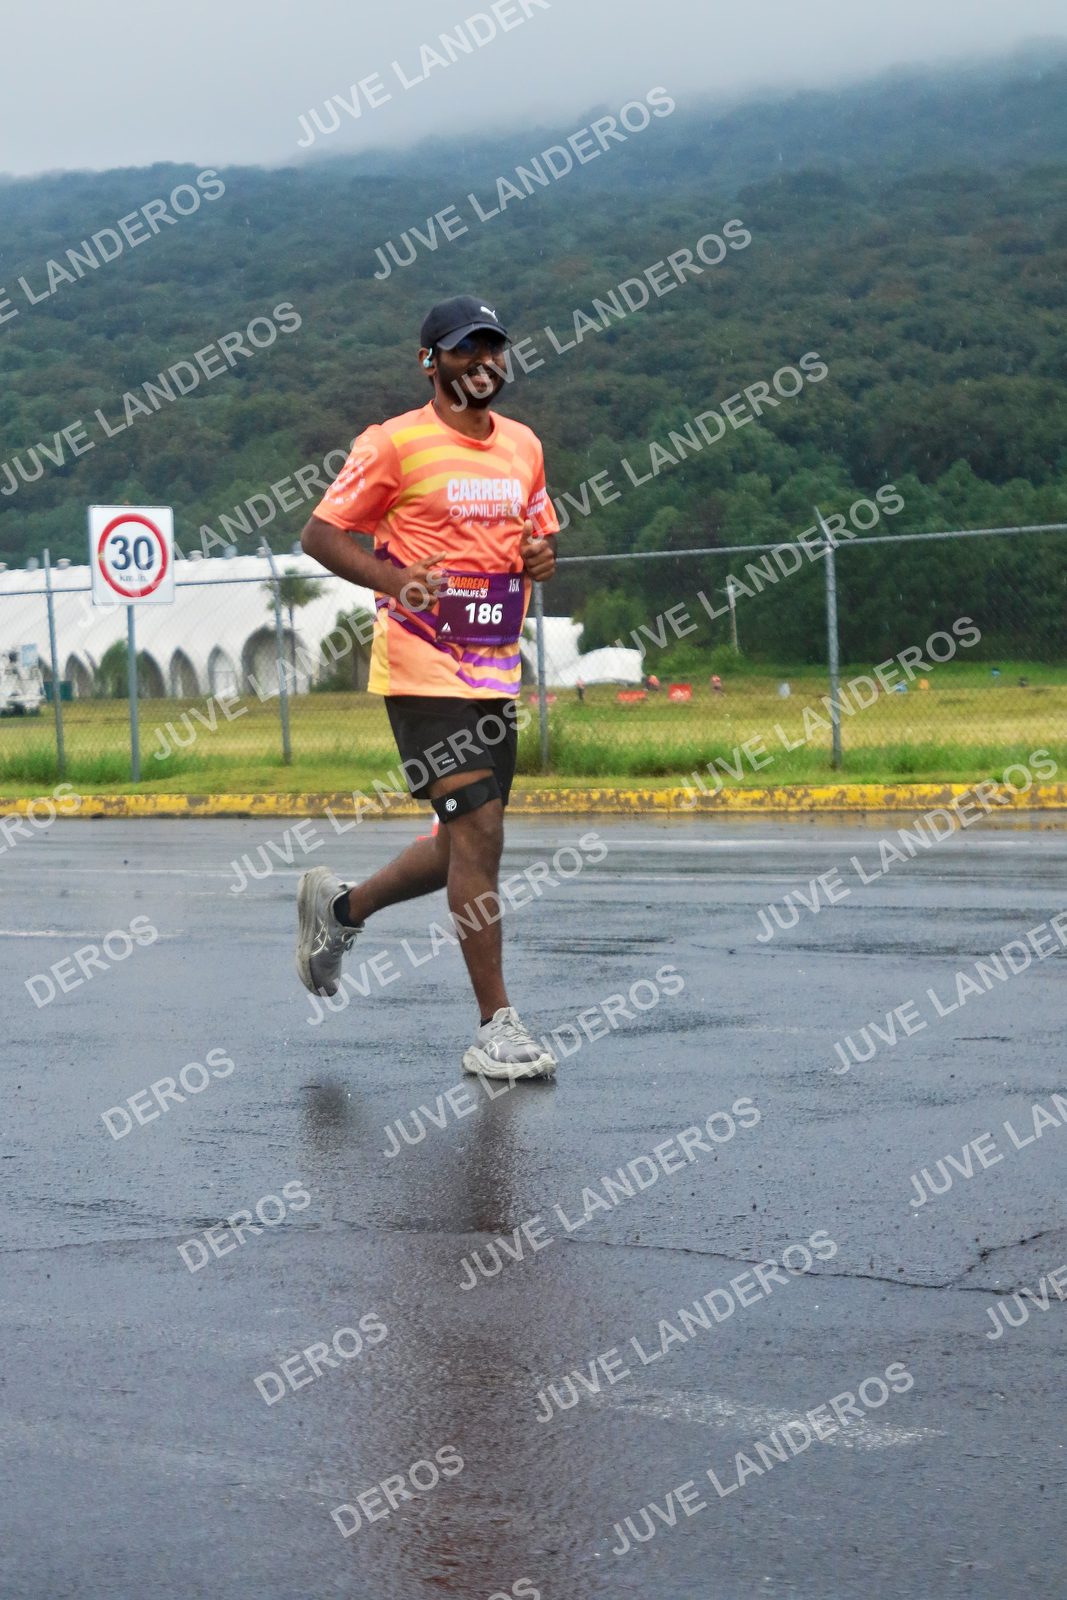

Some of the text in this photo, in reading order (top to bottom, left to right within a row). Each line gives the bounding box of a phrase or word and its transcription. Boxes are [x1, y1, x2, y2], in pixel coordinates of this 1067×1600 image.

[447, 478, 522, 502] CARRERA
[449, 503, 506, 519] OMNILIFE
[110, 535, 154, 570] 30
[448, 576, 490, 589] CARRERA
[508, 579, 520, 593] 15K
[446, 587, 479, 598] OMNILIFE
[465, 603, 503, 625] 186
